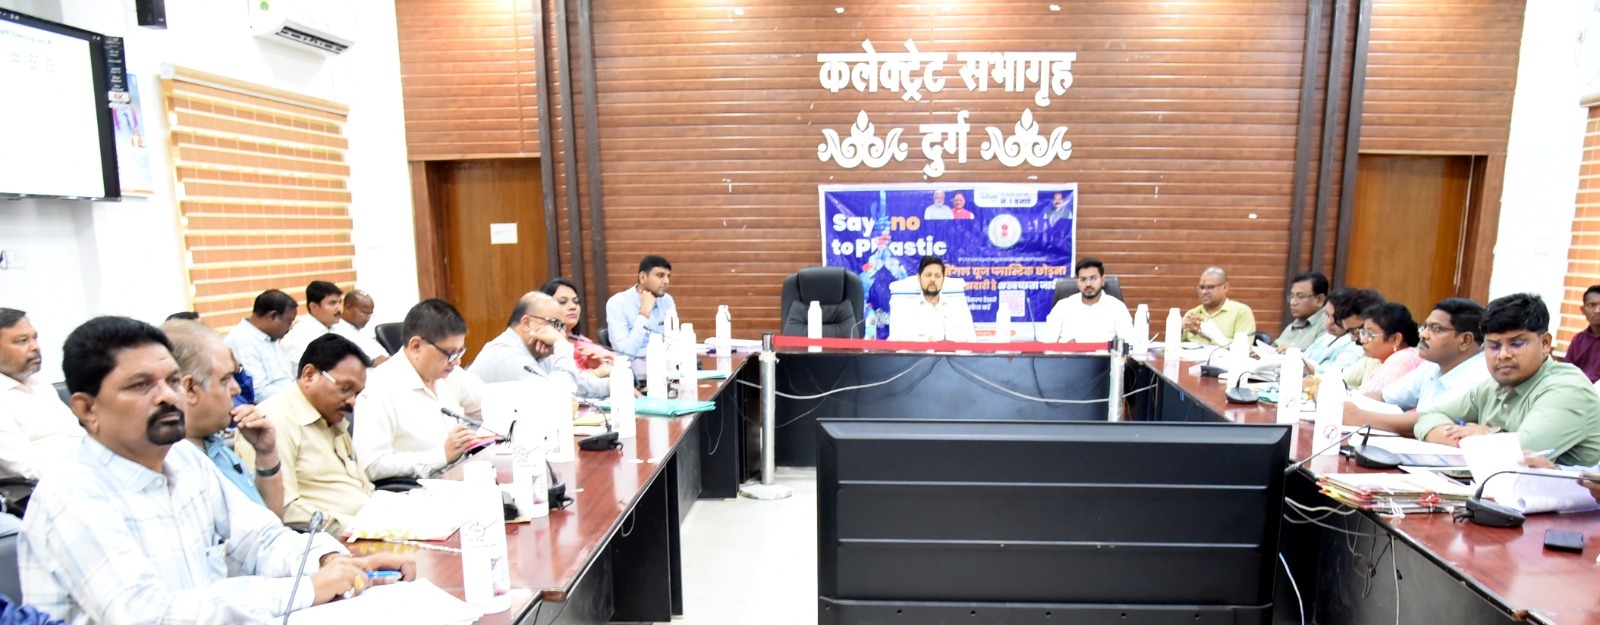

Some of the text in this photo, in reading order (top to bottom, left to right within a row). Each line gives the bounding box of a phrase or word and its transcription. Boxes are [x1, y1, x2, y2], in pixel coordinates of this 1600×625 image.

[817, 39, 1077, 107] कलेक्ट्रेट सभागृह
[919, 110, 970, 178] दुर्ग
[831, 239, 854, 256] to
[832, 213, 921, 237] Say no
